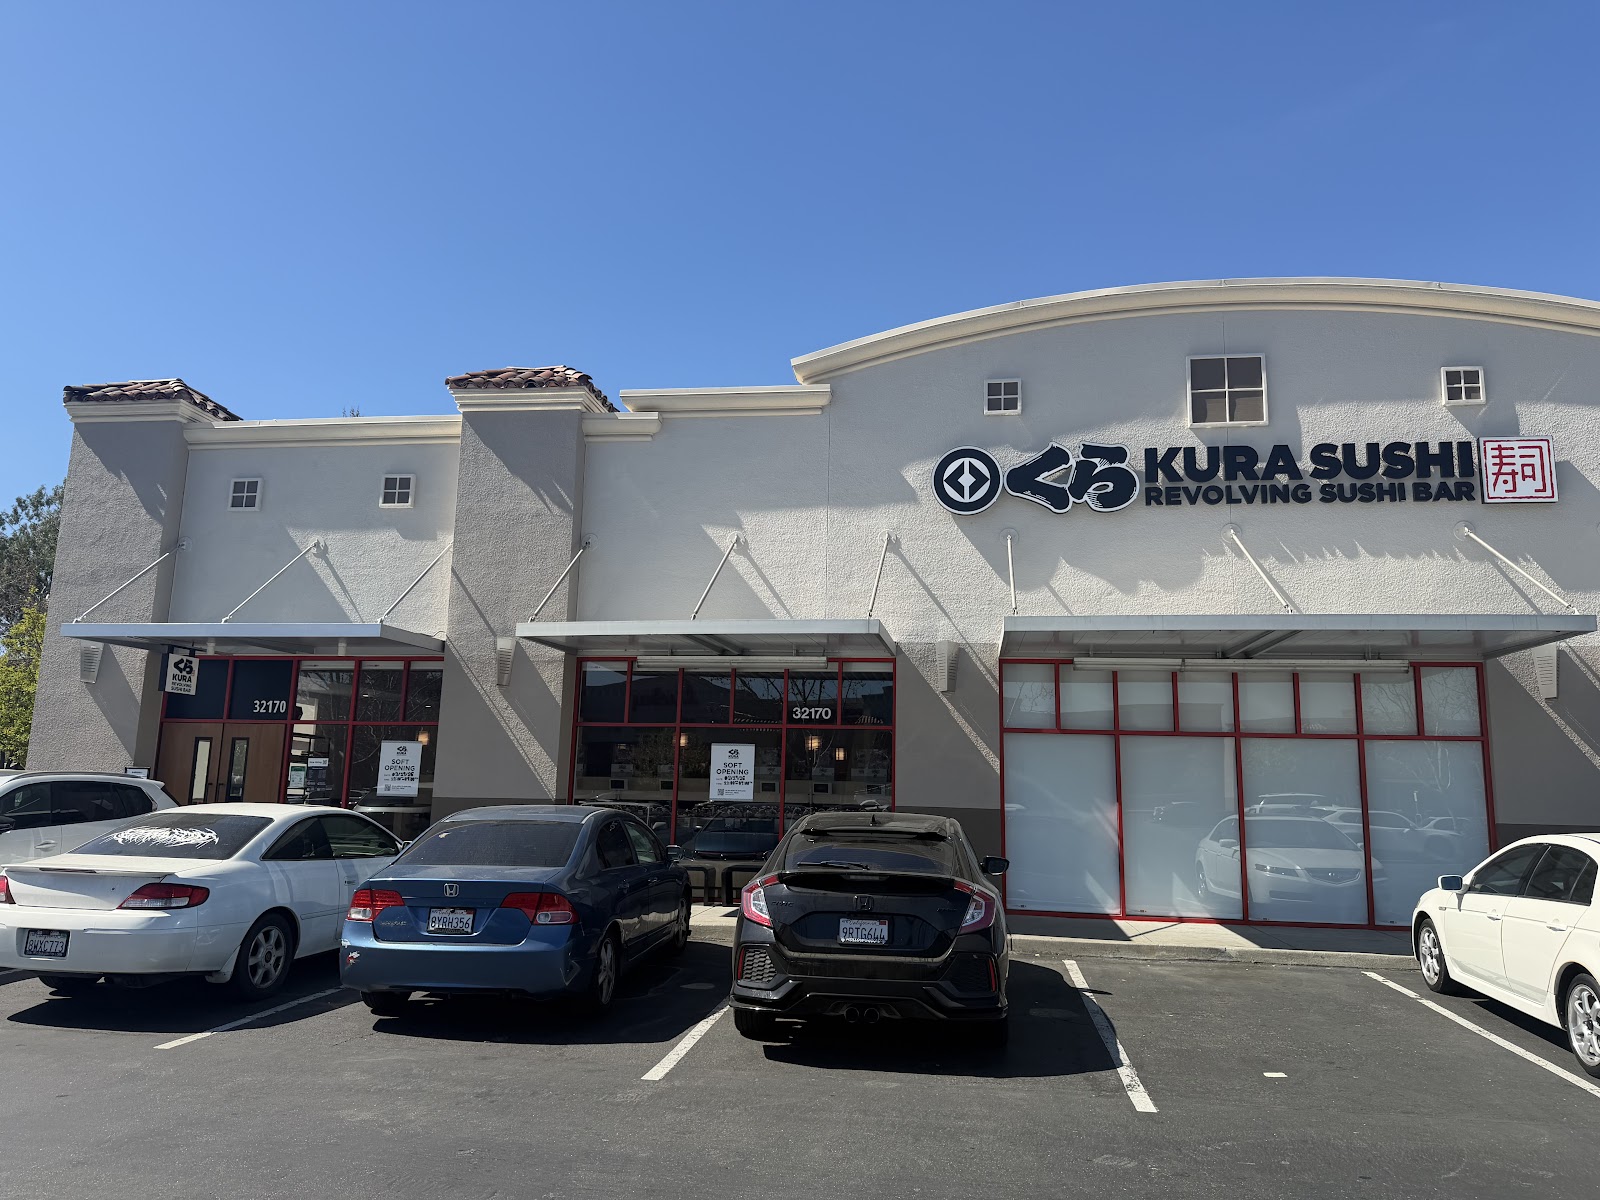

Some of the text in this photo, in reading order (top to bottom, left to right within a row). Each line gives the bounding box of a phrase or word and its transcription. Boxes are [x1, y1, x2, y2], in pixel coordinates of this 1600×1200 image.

[1144, 441, 1475, 484] KURA SUSHI
[1490, 444, 1547, 494] 寿司
[1004, 441, 1140, 513] くら
[1144, 480, 1476, 506] REVOLVING SUSHI BAR
[172, 673, 192, 683] KURA
[253, 700, 287, 713] 32170
[792, 707, 832, 719] 32170
[384, 764, 416, 772] OPENING
[430, 916, 471, 929] 8YRH356
[842, 926, 886, 941] 9RTG644
[28, 939, 65, 952] 8WXC773
